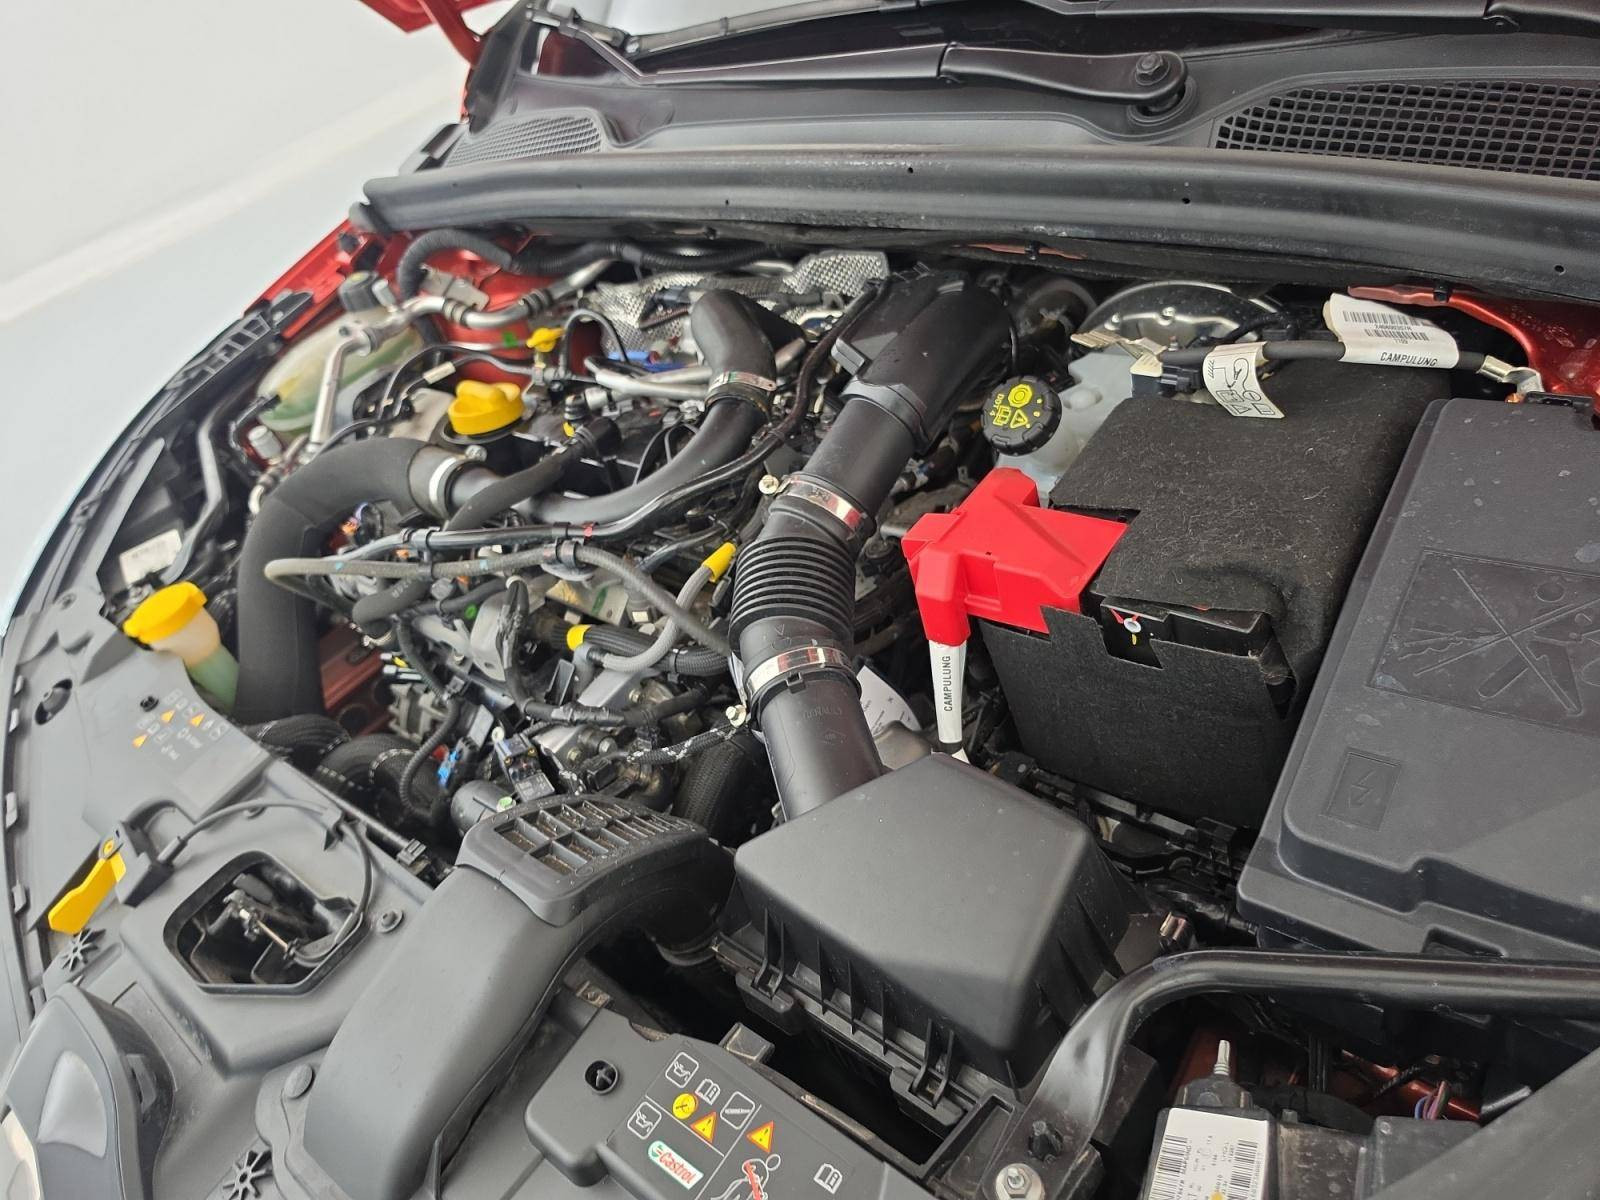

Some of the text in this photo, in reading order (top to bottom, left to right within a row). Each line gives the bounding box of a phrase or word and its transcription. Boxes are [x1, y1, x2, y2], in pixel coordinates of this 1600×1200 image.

[1380, 351, 1438, 367] CAMPULUNG
[993, 393, 1005, 409] DOT
[942, 655, 953, 712] CAMPULUNG
[659, 1152, 696, 1184] Castrol
